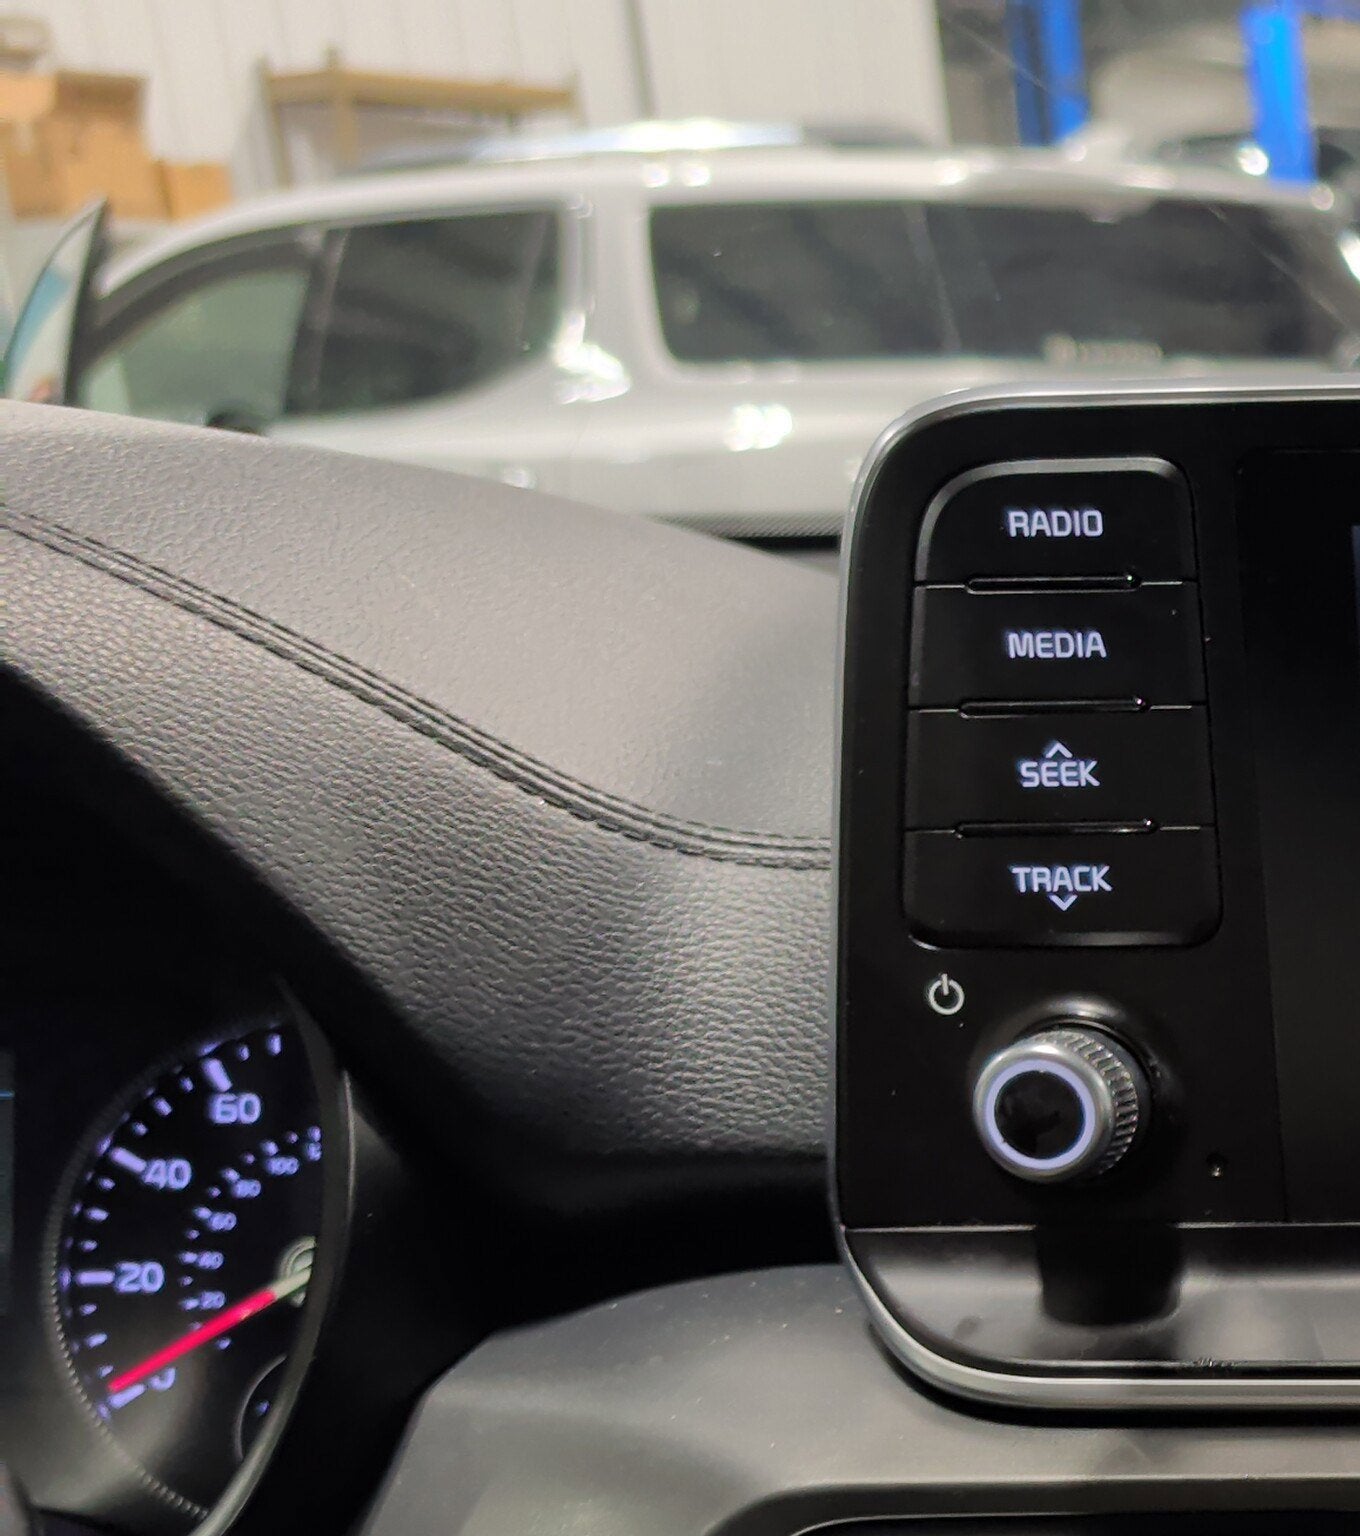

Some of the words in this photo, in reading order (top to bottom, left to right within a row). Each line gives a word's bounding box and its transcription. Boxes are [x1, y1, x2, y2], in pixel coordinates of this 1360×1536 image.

[1007, 509, 1104, 538] RADIO
[1006, 631, 1107, 659] MEDIA
[1020, 760, 1100, 788] SEEK
[1012, 866, 1112, 892] TRACK
[208, 1092, 262, 1124] 60
[141, 1158, 192, 1190] 40
[113, 1261, 165, 1293] 20
